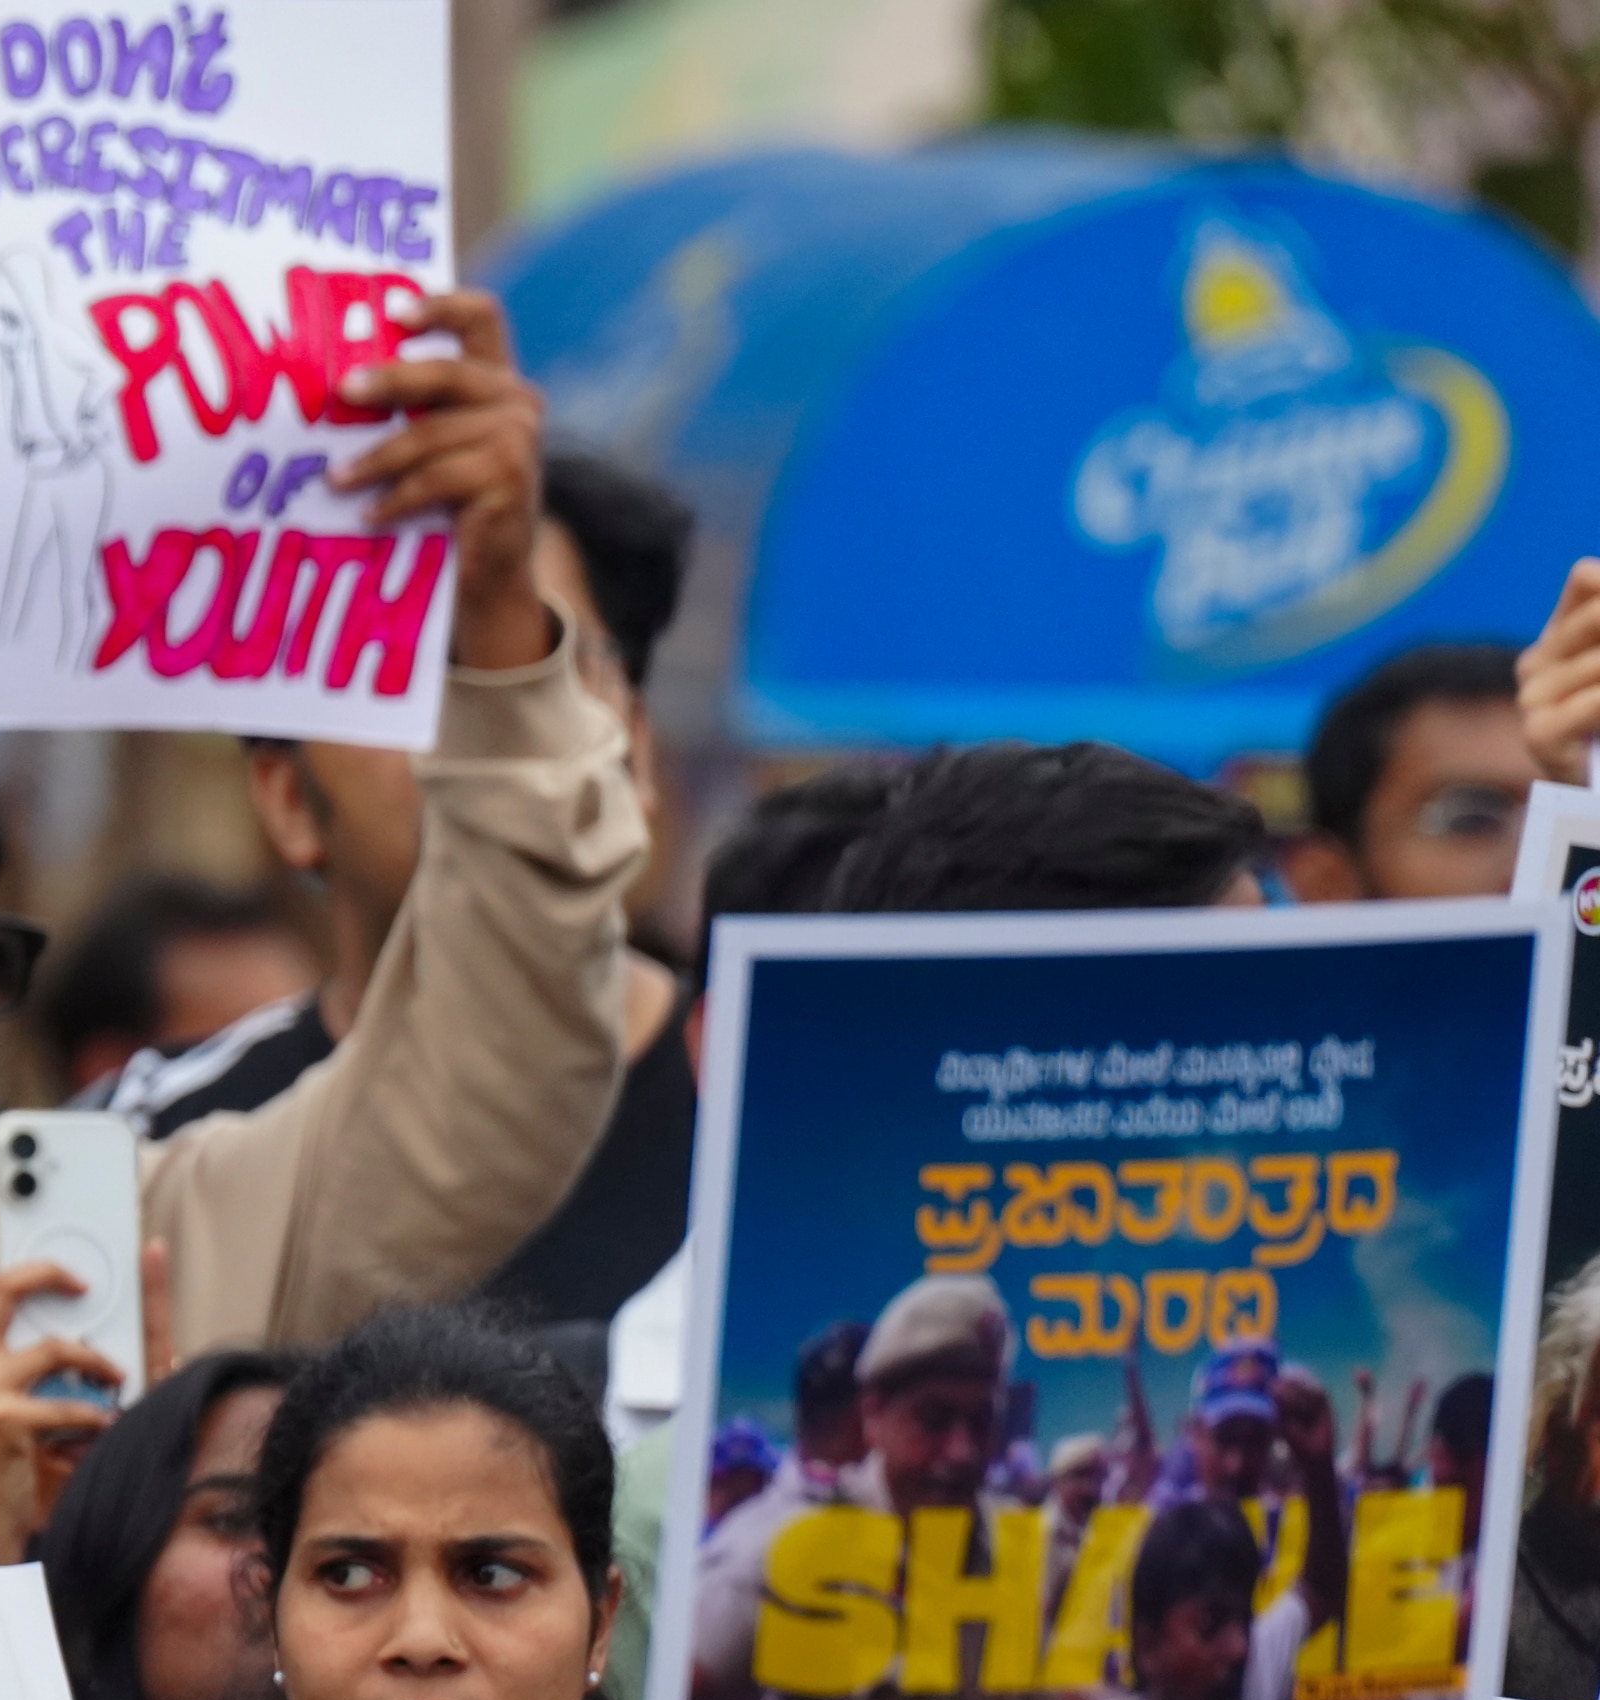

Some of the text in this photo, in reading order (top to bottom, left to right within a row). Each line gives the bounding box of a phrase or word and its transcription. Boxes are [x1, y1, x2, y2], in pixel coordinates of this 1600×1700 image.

[51, 207, 191, 274] THE
[224, 451, 327, 517] OF
[93, 528, 452, 696] YOUTH
[1026, 1267, 1279, 1359] ಮರಣ
[753, 1485, 1468, 1696] SHAE
